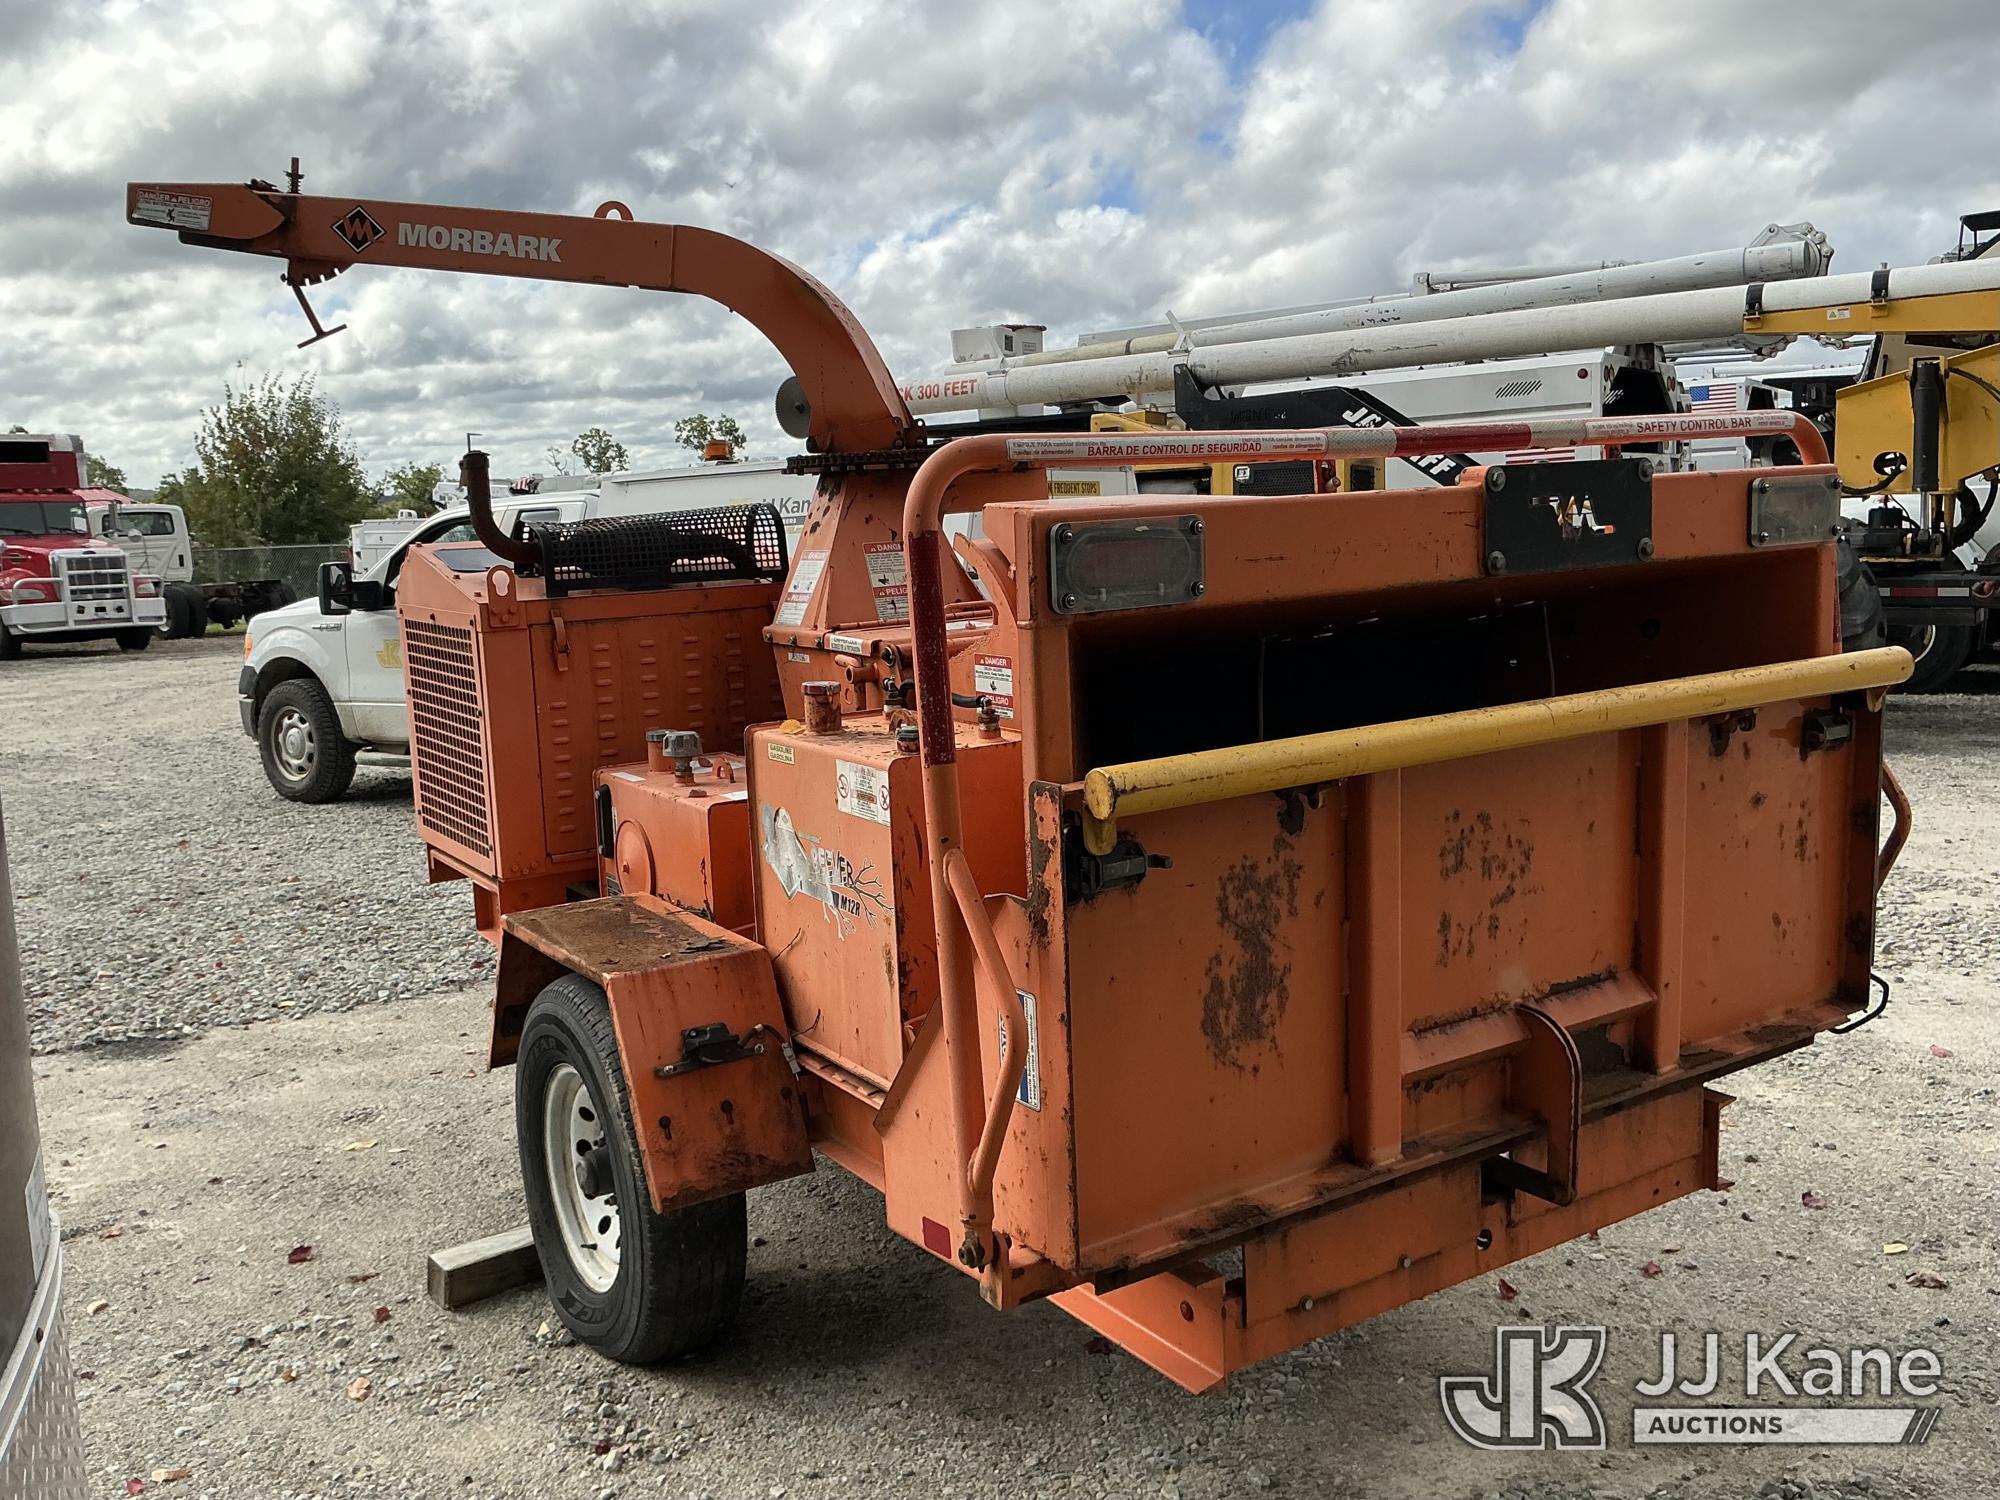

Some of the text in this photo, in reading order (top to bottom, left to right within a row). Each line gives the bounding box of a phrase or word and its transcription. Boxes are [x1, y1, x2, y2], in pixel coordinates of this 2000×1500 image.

[138, 191, 170, 202] DANGER
[177, 196, 210, 207] PELIGRO
[398, 222, 562, 263] MORBARK
[917, 383, 940, 400] 300
[943, 378, 978, 398] FEET
[1636, 421, 1677, 433] SAFETY
[1680, 418, 1729, 432] CONTROL
[1730, 417, 1752, 429] BAR
[1087, 442, 1262, 457] BARRA DE CONTROL DE SEGURIDAD
[1054, 482, 1080, 494] FREQUENT
[1081, 482, 1097, 494] STOPS
[780, 496, 811, 514] Kan
[877, 543, 903, 552] DANG
[984, 656, 1007, 667] DANGER
[840, 895, 861, 917] M12R
